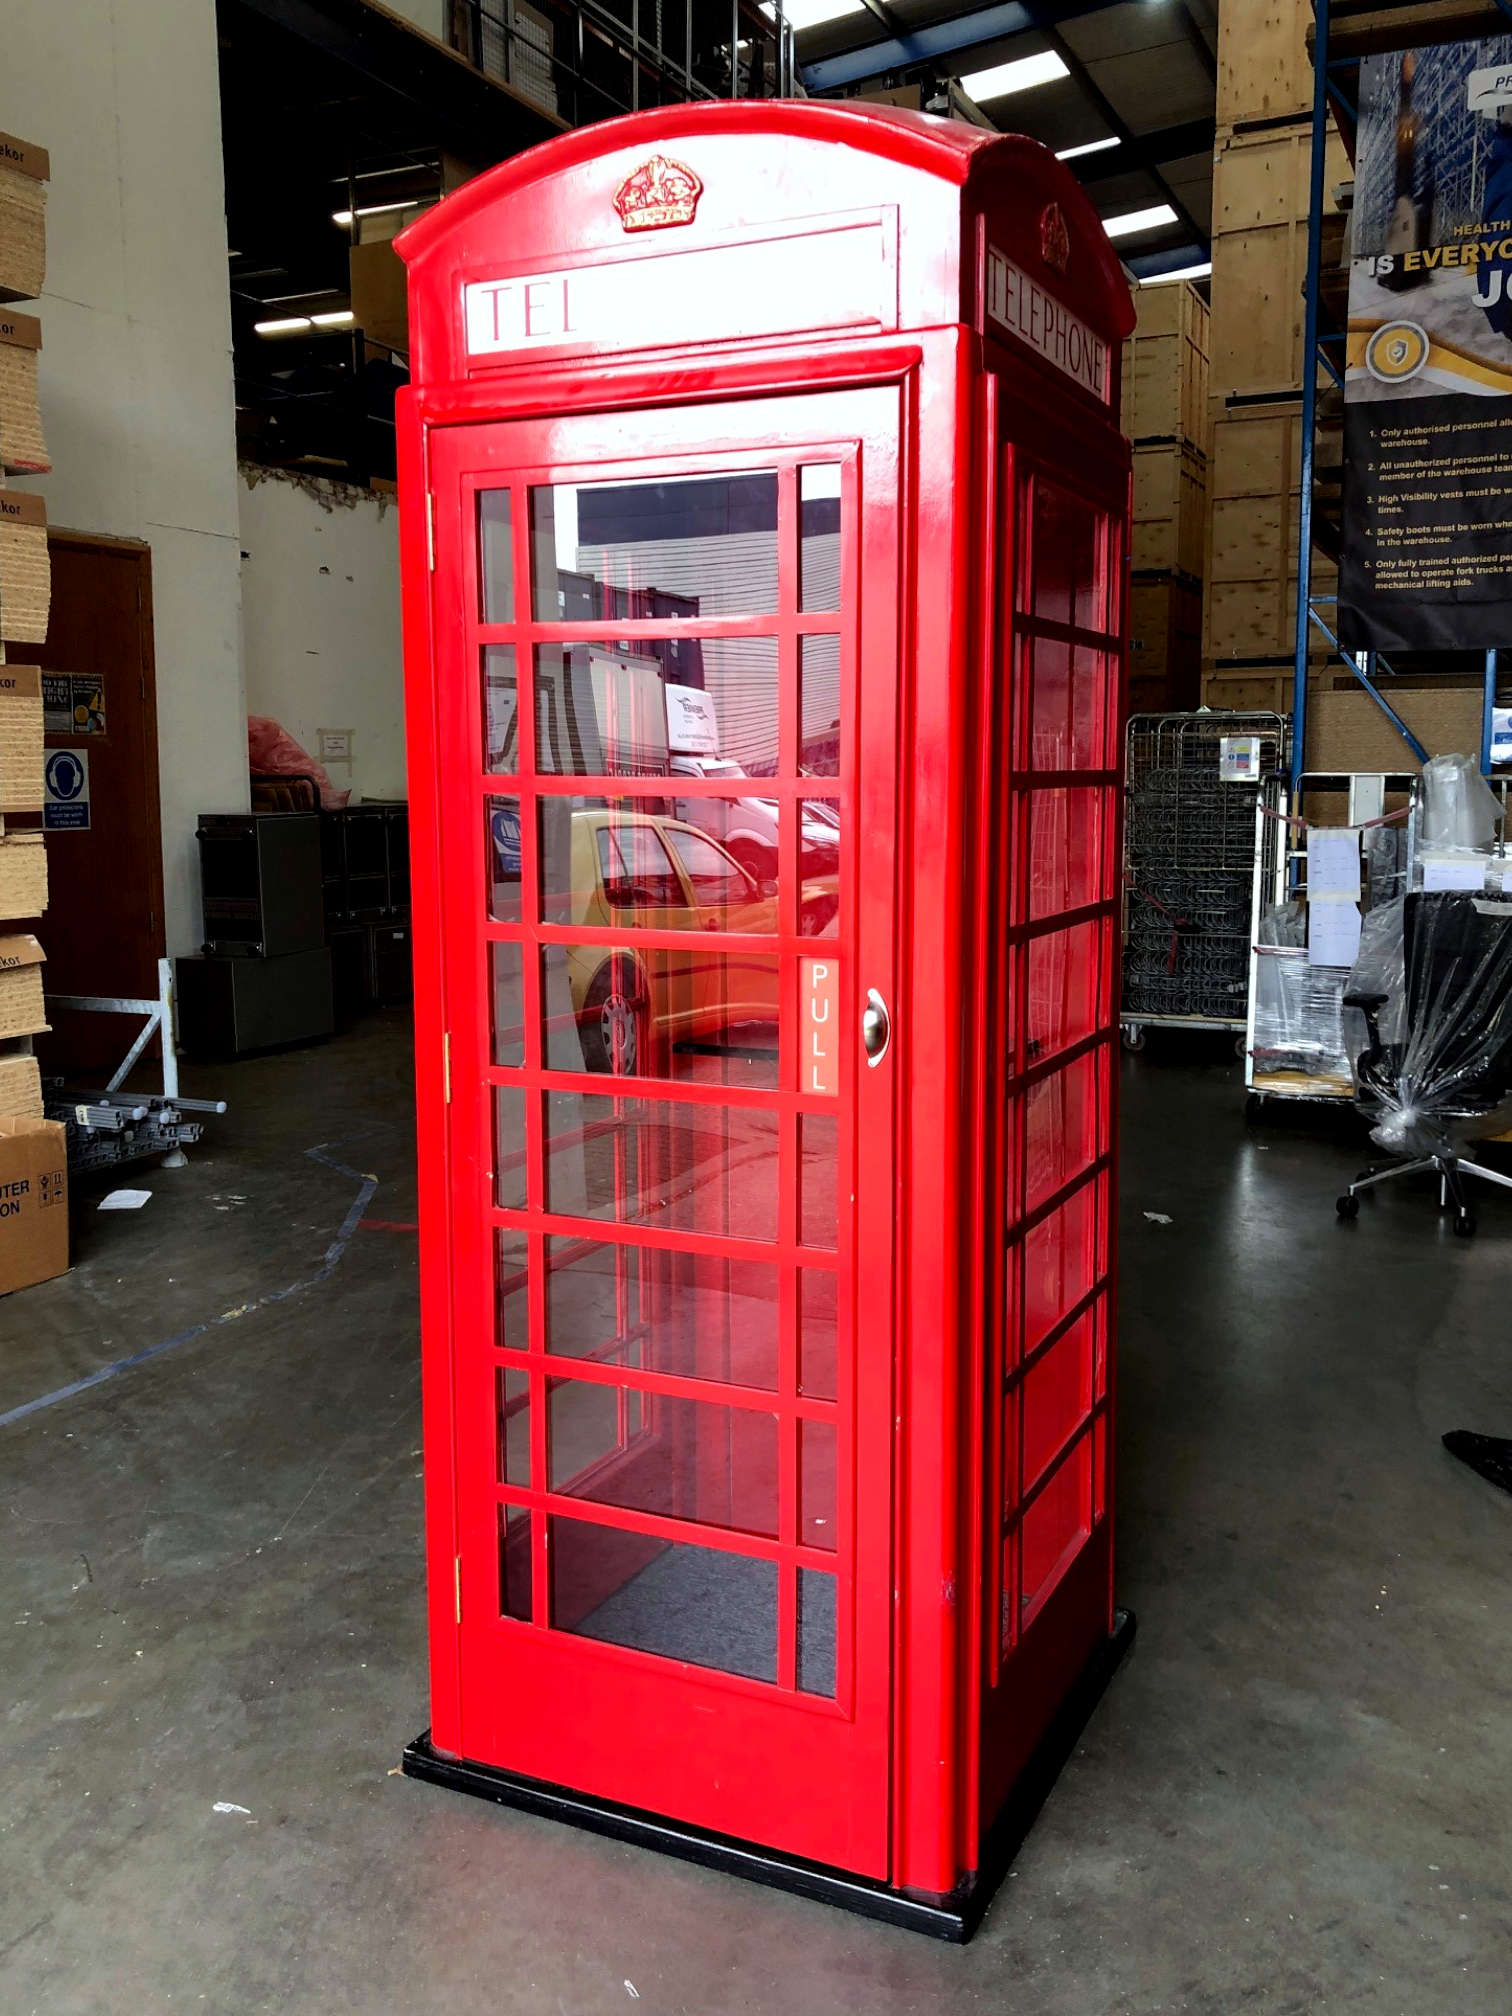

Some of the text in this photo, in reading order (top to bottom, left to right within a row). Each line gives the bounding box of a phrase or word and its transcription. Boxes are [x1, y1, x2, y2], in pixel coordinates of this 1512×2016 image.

[1454, 220, 1510, 236] HEALTH
[1368, 255, 1394, 276] IS
[1472, 270, 1512, 308] J
[988, 249, 1102, 393] TELEPHONE
[1380, 428, 1401, 438] Only
[1403, 423, 1451, 436] authorised
[1452, 419, 1498, 432] personnel
[1380, 438, 1430, 448] warehouse.
[1379, 461, 1392, 471] All
[1393, 458, 1451, 470] unauthorized
[1452, 453, 1498, 466] personnel
[1499, 453, 1510, 461] to
[1378, 472, 1414, 481] member
[1416, 471, 1426, 479] of
[1427, 469, 1441, 478] the
[1443, 466, 1493, 477] warehouse
[1377, 495, 1399, 505] High
[1400, 491, 1438, 503] Visibility
[1440, 490, 1464, 499] vests
[1465, 488, 1489, 498] must
[1490, 487, 1502, 495] be
[1377, 505, 1404, 514] times.
[1376, 527, 1405, 537] Safety
[1406, 525, 1431, 534] boots
[1432, 523, 1456, 533] must
[1457, 522, 1468, 531] be
[1470, 521, 1493, 530] worn
[1387, 538, 1402, 546] the
[1402, 535, 1453, 546] warehouse.
[1375, 560, 1397, 569] Only
[1398, 558, 1417, 568] fully
[1418, 556, 1449, 566] trained
[1451, 553, 1498, 565] authorized
[1375, 568, 1409, 579] allowed
[1410, 569, 1420, 578] to
[1421, 568, 1455, 578] operate
[1456, 566, 1475, 575] fork
[1476, 564, 1504, 574] trucks
[1374, 577, 1473, 590] mechanical lifting aids.
[811, 964, 828, 1090] PULL
[0, 1180, 30, 1199] TER
